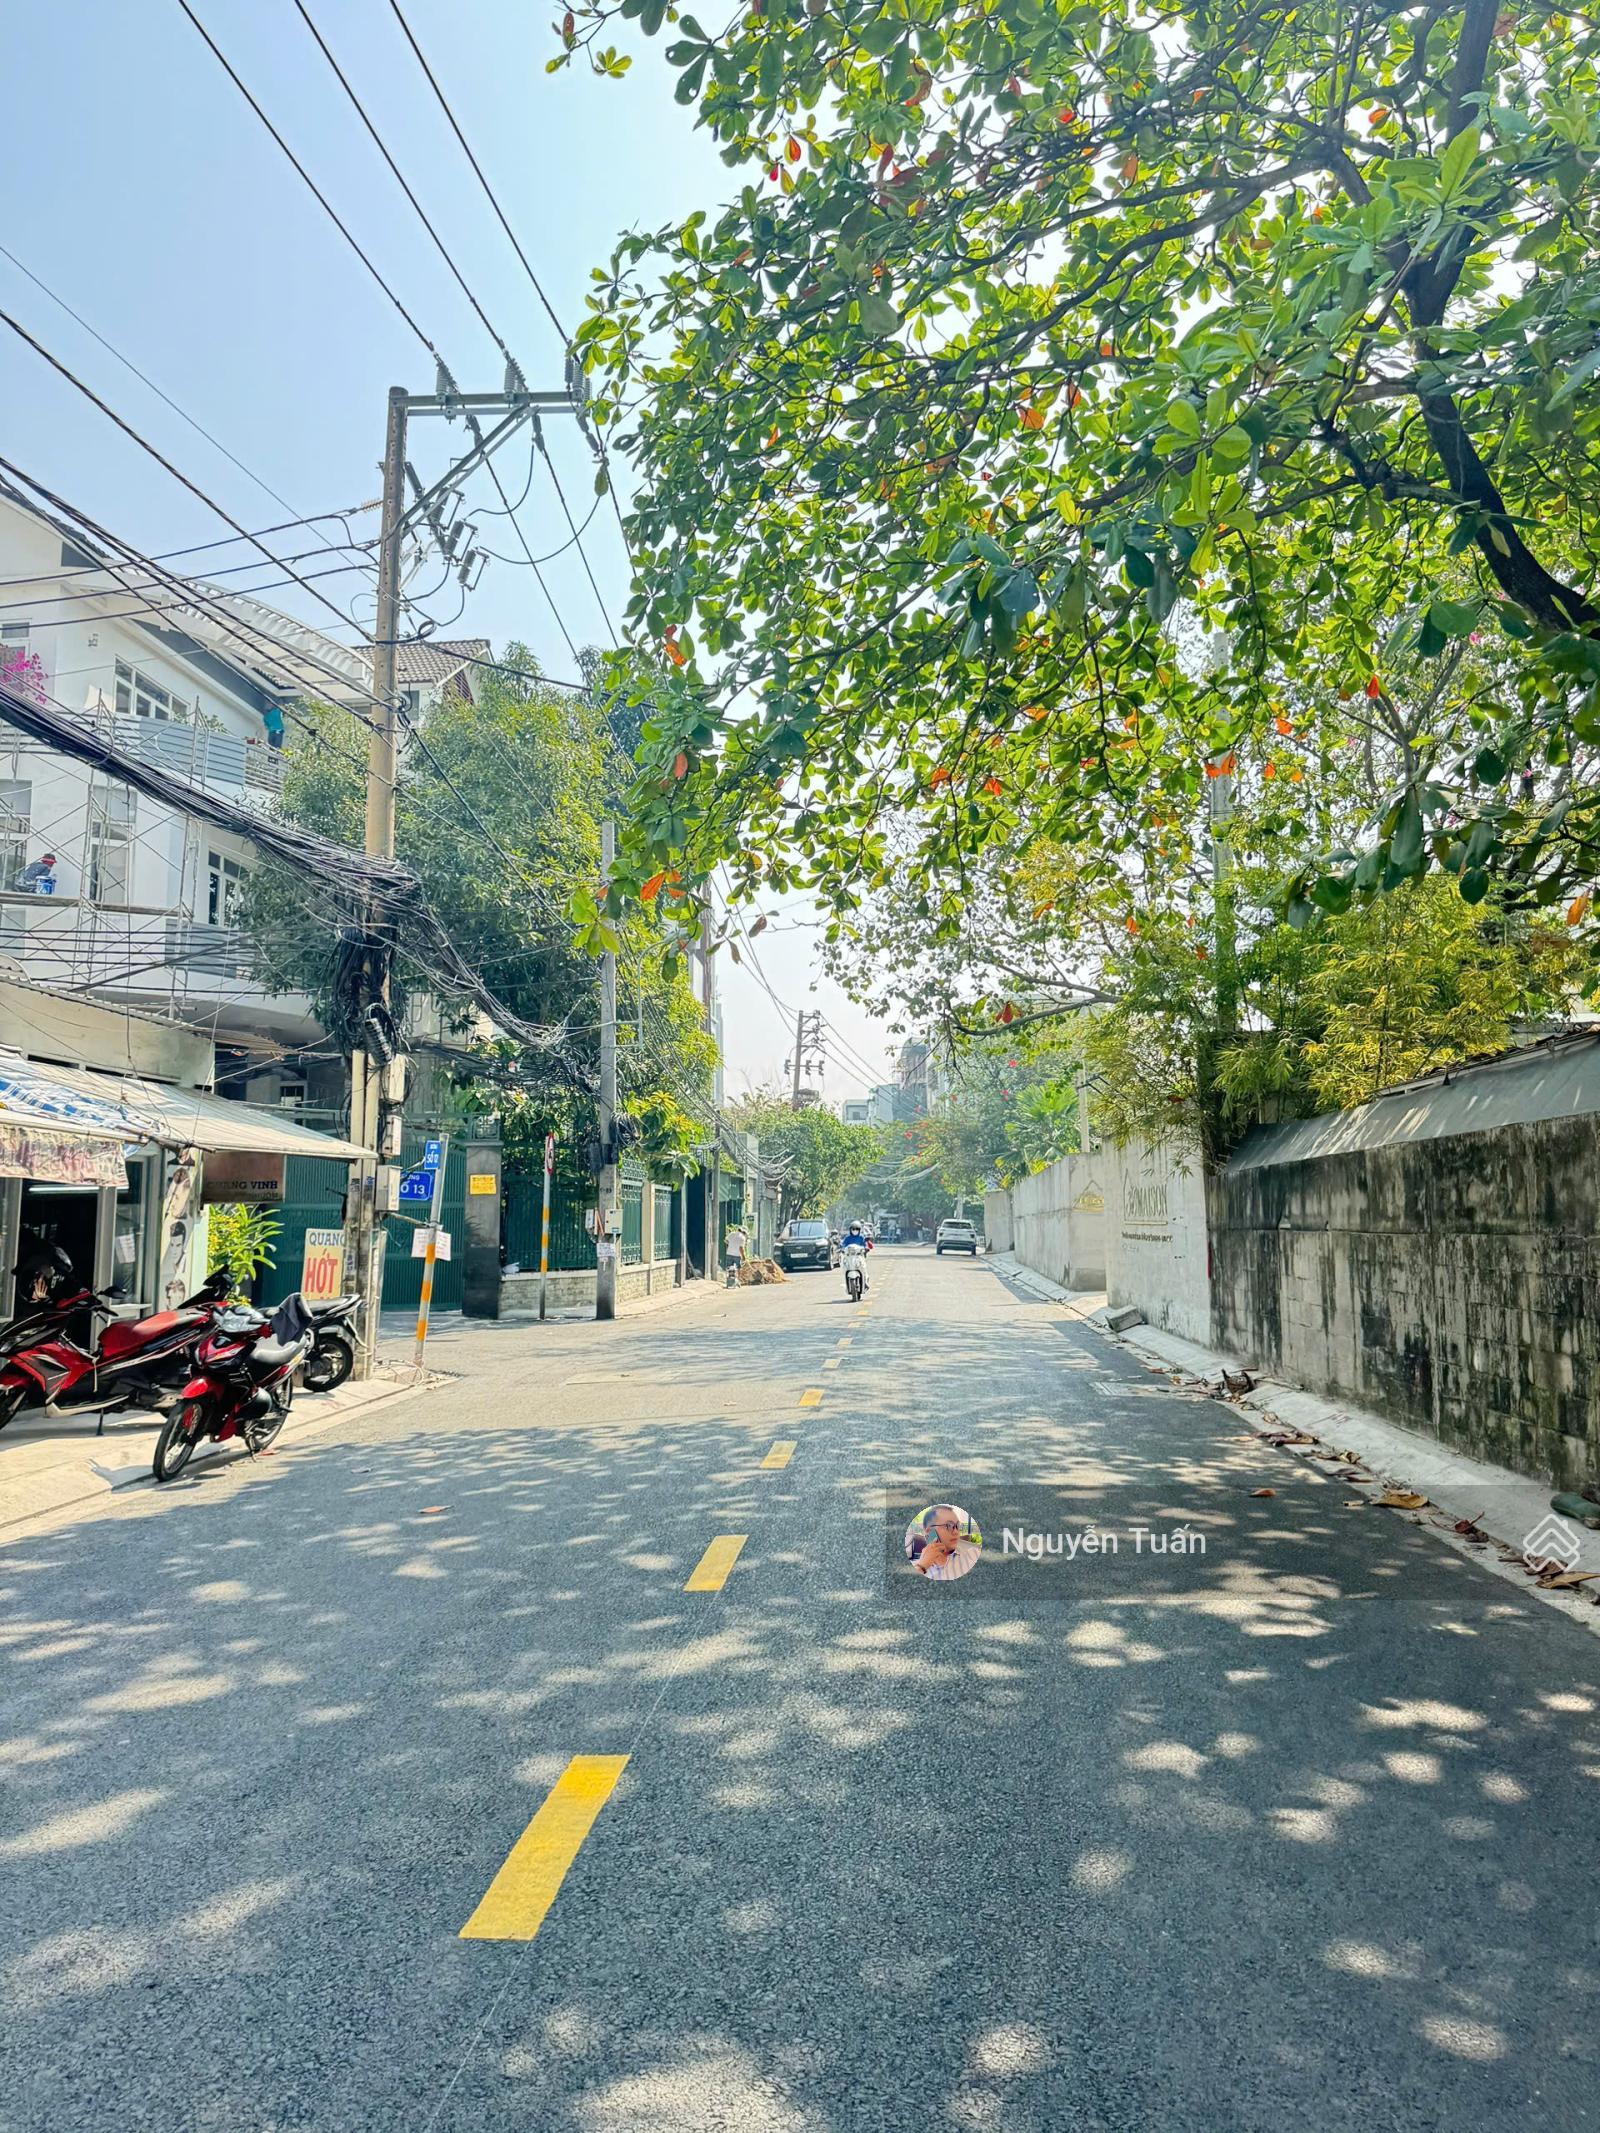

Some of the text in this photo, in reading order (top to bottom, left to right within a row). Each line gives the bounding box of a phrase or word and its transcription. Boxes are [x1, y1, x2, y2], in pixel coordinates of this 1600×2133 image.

[250, 1180, 278, 1190] VINH
[400, 1180, 425, 1195] Ố 13
[304, 1248, 338, 1294] HỚT
